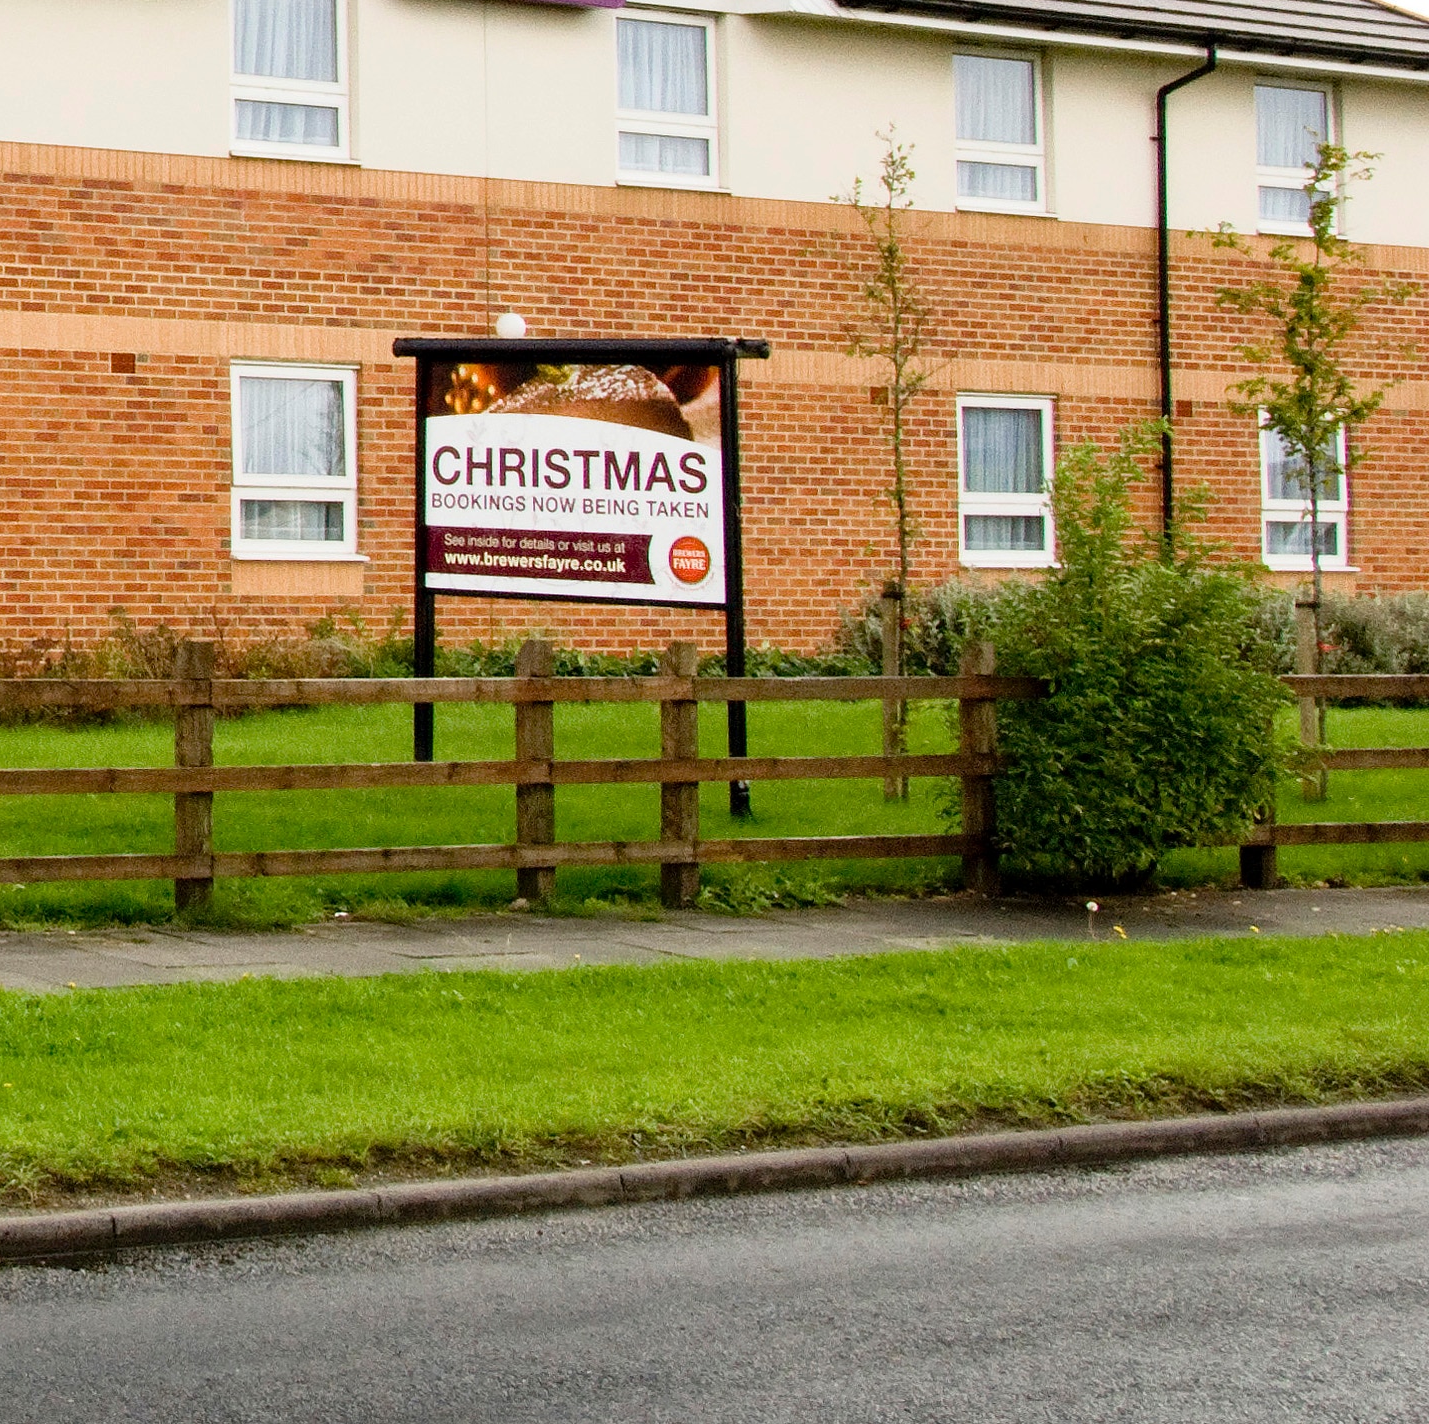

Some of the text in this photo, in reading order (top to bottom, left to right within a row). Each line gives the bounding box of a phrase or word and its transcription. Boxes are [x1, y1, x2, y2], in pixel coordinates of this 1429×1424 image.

[432, 445, 708, 494] CHRISTMAS
[432, 493, 709, 518] BOOKINGS NOW BEING TAKEN
[444, 533, 626, 554] See inside for details or visit us at
[444, 552, 626, 573] www.brewersfayre.co.uk
[673, 557, 707, 571] FAYRE
